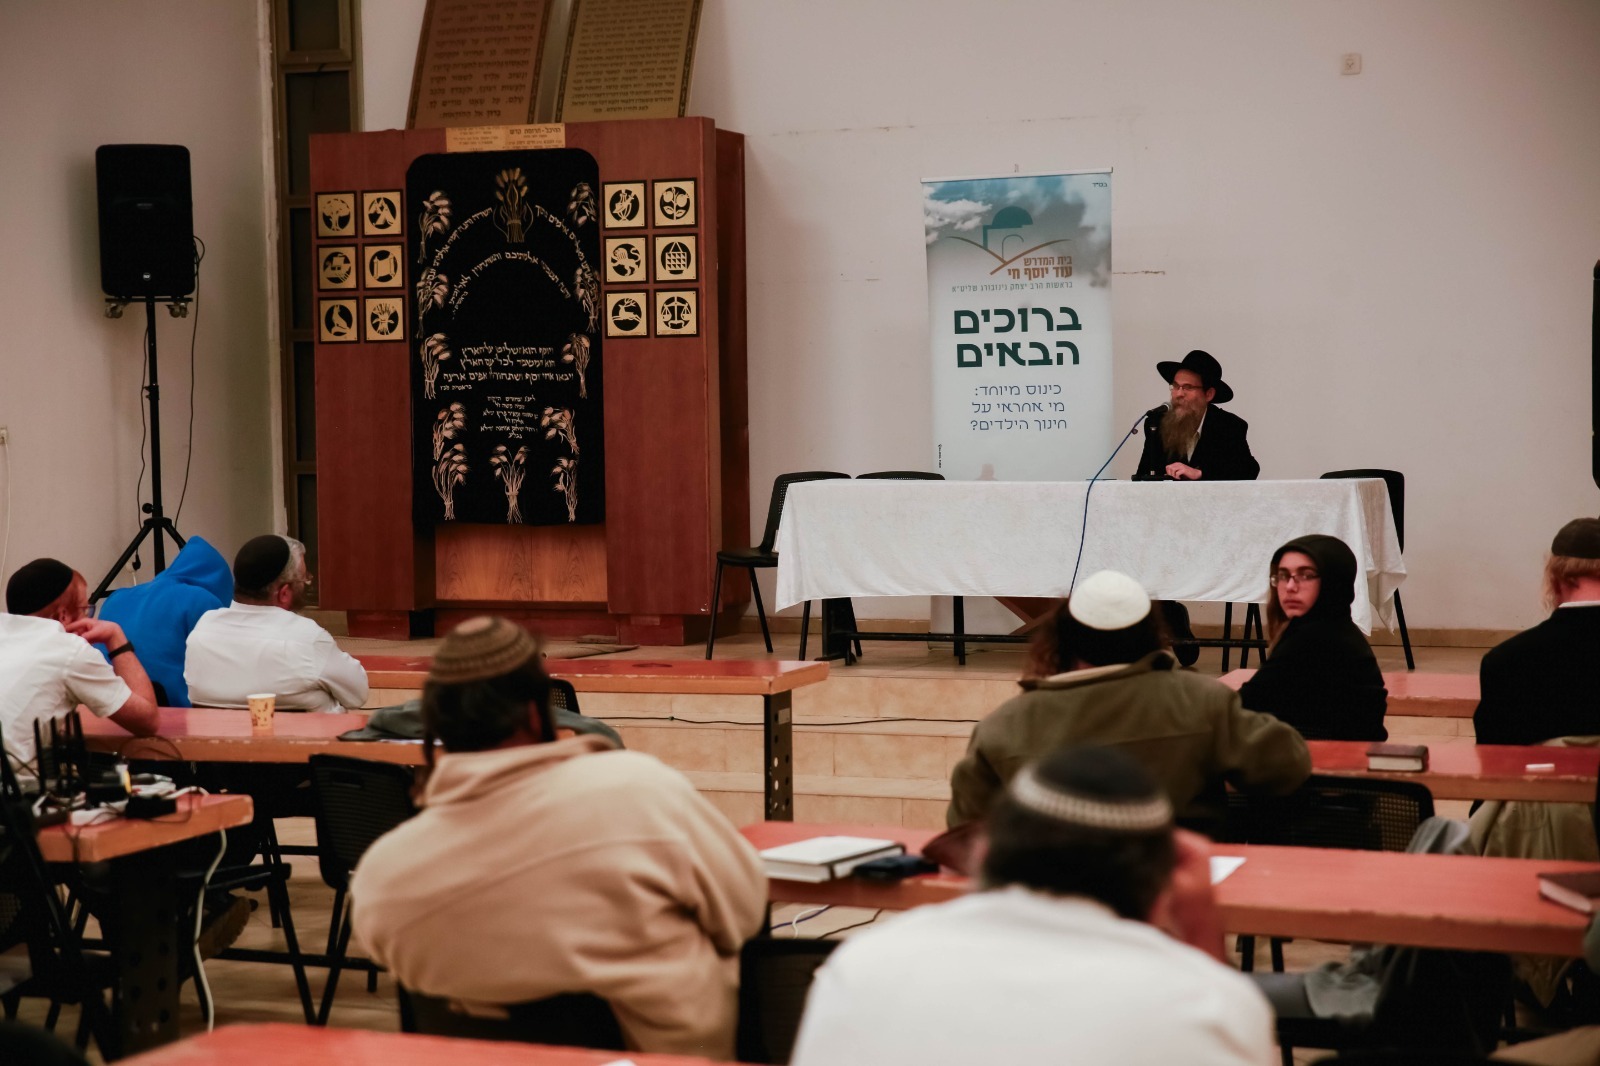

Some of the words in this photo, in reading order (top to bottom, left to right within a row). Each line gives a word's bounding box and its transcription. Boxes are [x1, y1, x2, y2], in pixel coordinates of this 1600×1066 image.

[1023, 256, 1054, 266] המדרש
[1058, 255, 1073, 265] בית
[1007, 268, 1020, 280] חי
[1024, 267, 1049, 281] יוסף
[1053, 266, 1073, 278] עוד
[951, 285, 978, 293] שליט״א
[980, 283, 1008, 292] גינזבורג
[1010, 282, 1028, 291] יצחק
[1030, 282, 1043, 290] הרב
[1046, 281, 1073, 289] בראשות
[954, 306, 1082, 335] ברוכים
[957, 340, 1080, 368] הבאים
[975, 384, 1021, 396] מיוחד:
[1026, 383, 1062, 395] כינוס
[971, 401, 992, 414] על
[997, 402, 1044, 413] אחראי
[1049, 401, 1065, 412] מי
[970, 418, 1029, 431] הילדים?
[1034, 418, 1067, 432] חינוך
